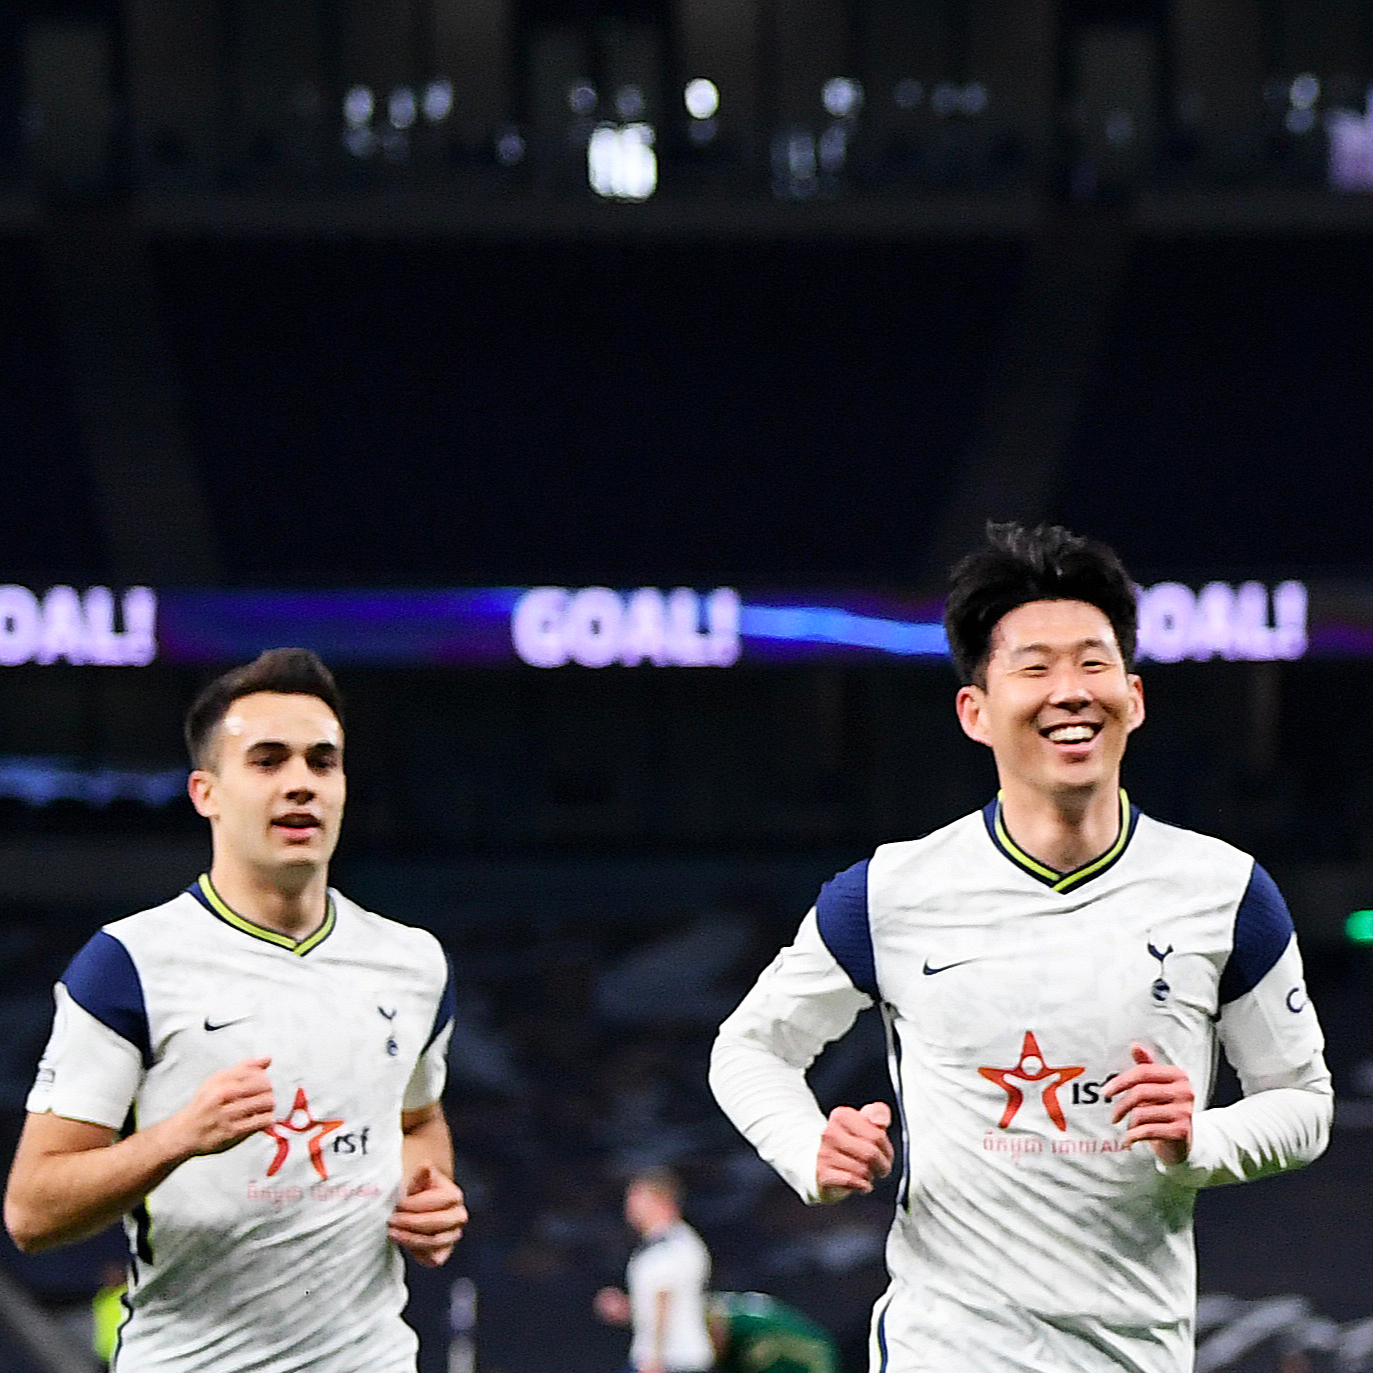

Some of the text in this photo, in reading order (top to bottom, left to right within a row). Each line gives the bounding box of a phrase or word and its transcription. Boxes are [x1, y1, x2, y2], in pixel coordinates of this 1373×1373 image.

[0, 583, 157, 667] OAL!
[512, 585, 742, 668] GOAL!
[1134, 579, 1308, 664] OAL!
